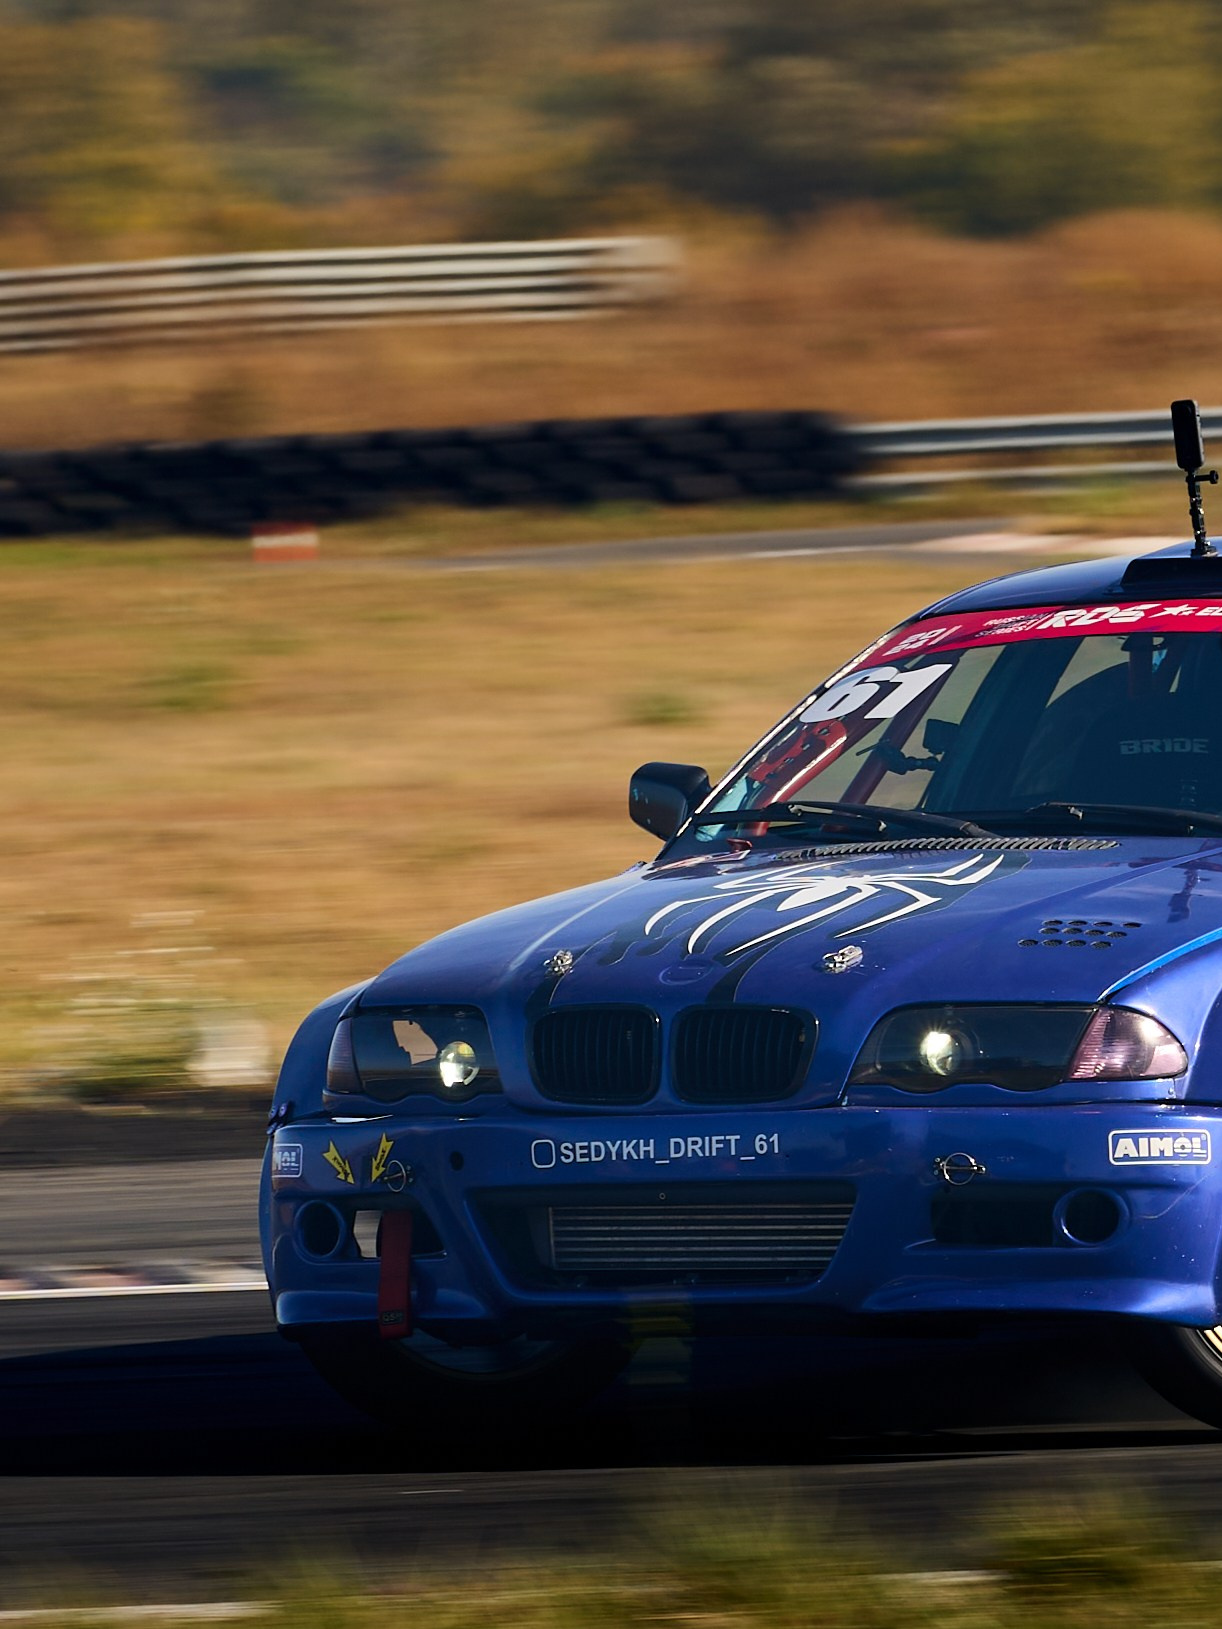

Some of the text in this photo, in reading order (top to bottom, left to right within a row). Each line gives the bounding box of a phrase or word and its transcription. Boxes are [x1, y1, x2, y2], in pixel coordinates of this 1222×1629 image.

[1037, 603, 1162, 629] RDS
[799, 664, 953, 723] 61
[1119, 738, 1209, 754] BRIDE
[560, 1133, 780, 1164] SEDYKH_DRIFT_61
[1113, 1136, 1207, 1158] AIMOL
